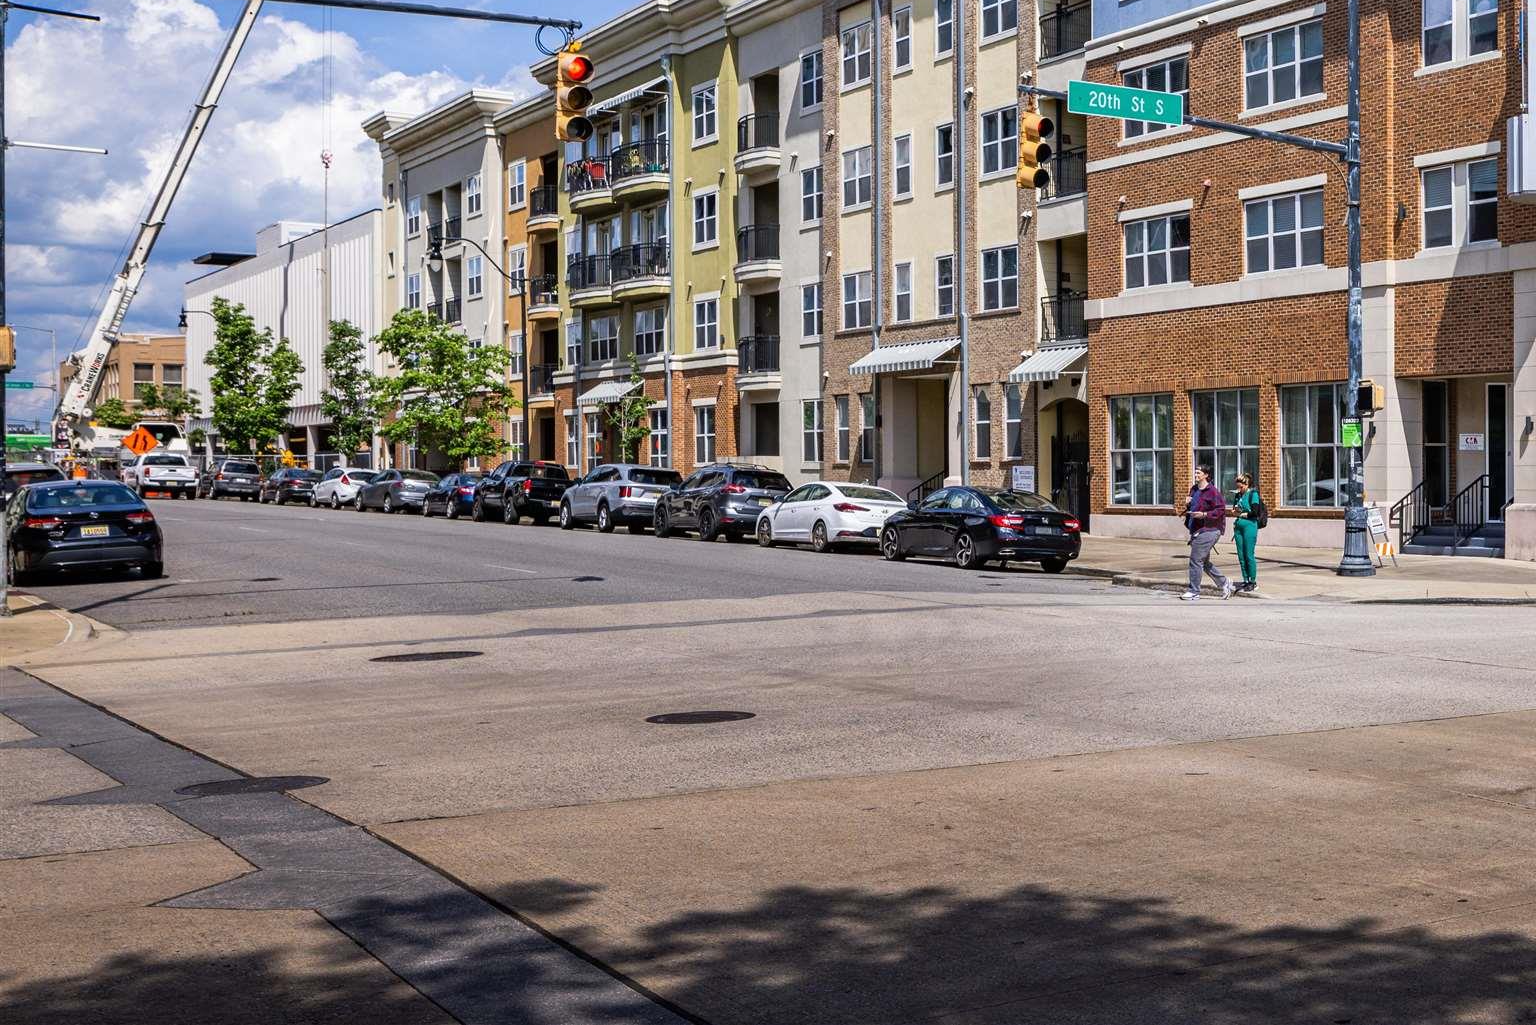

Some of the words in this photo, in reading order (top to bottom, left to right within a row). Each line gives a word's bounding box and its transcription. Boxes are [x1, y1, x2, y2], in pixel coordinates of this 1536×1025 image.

[1089, 90, 1120, 110] 20th
[1131, 96, 1145, 113] St
[1155, 99, 1164, 115] S
